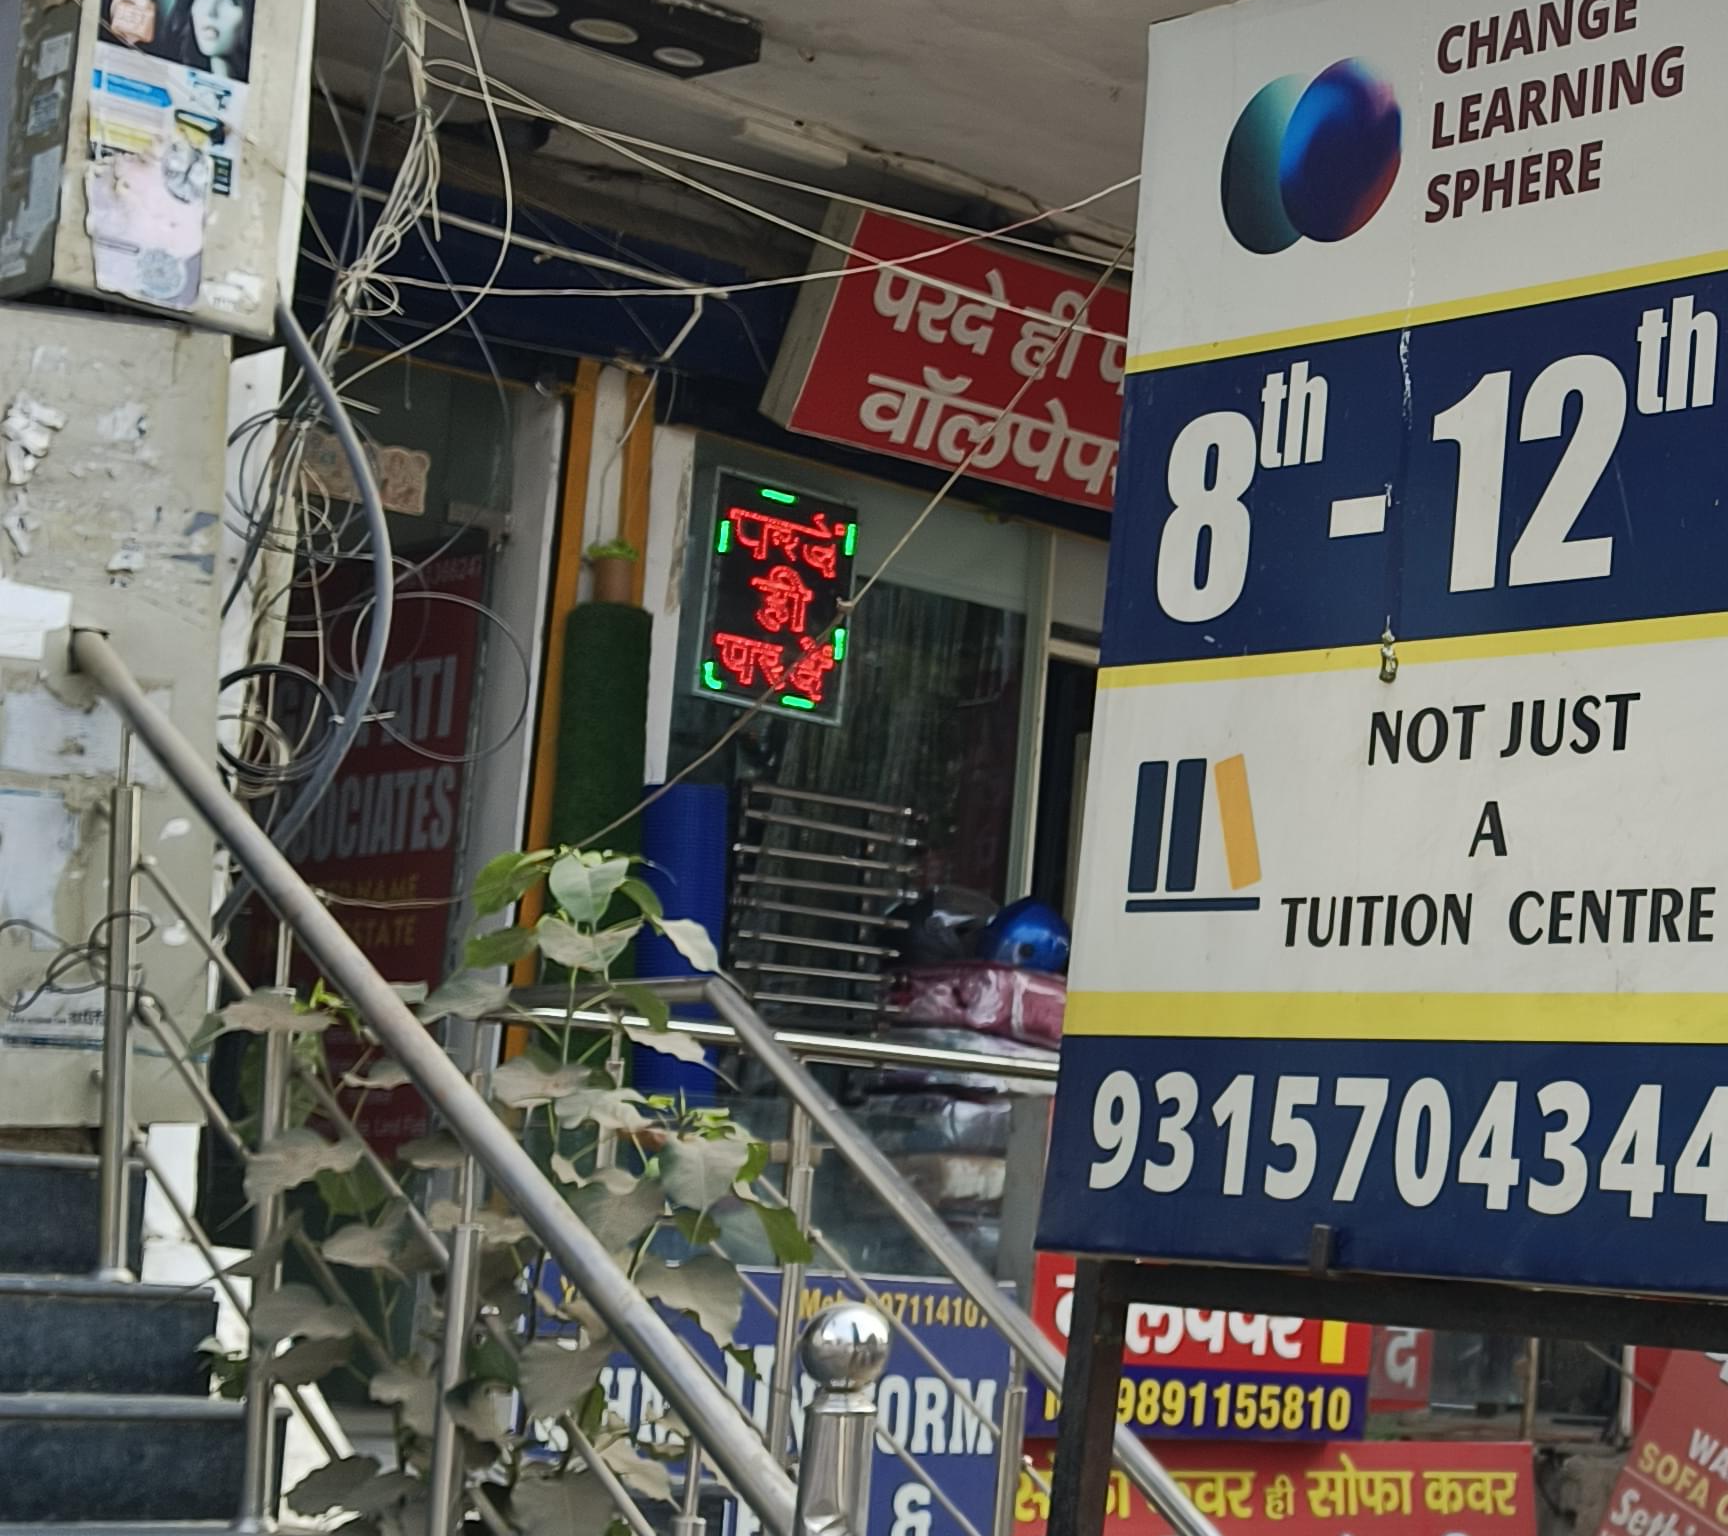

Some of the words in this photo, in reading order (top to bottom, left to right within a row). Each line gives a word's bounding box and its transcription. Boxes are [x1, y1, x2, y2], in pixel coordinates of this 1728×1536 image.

[1430, 44, 1688, 151] LEARNING
[1424, 139, 1606, 225] SPHERE
[873, 267, 1012, 357] परदे
[1010, 289, 1093, 382] ही
[858, 365, 1121, 499] वॉलपेप
[1432, 293, 1721, 597] 12th
[750, 564, 815, 634] ही
[1367, 703, 1487, 768] NOT
[1498, 690, 1643, 762] JUST
[1467, 799, 1509, 860] A
[1280, 891, 1475, 951] TUITION
[1507, 884, 1719, 946] CENTRE
[1116, 1376, 1353, 1432] 9891155810
[1263, 1472, 1297, 1522] ही
[1305, 1452, 1415, 1518] सोफा
[1422, 1470, 1520, 1518] कवर
[1637, 1441, 1712, 1509] SOFA
